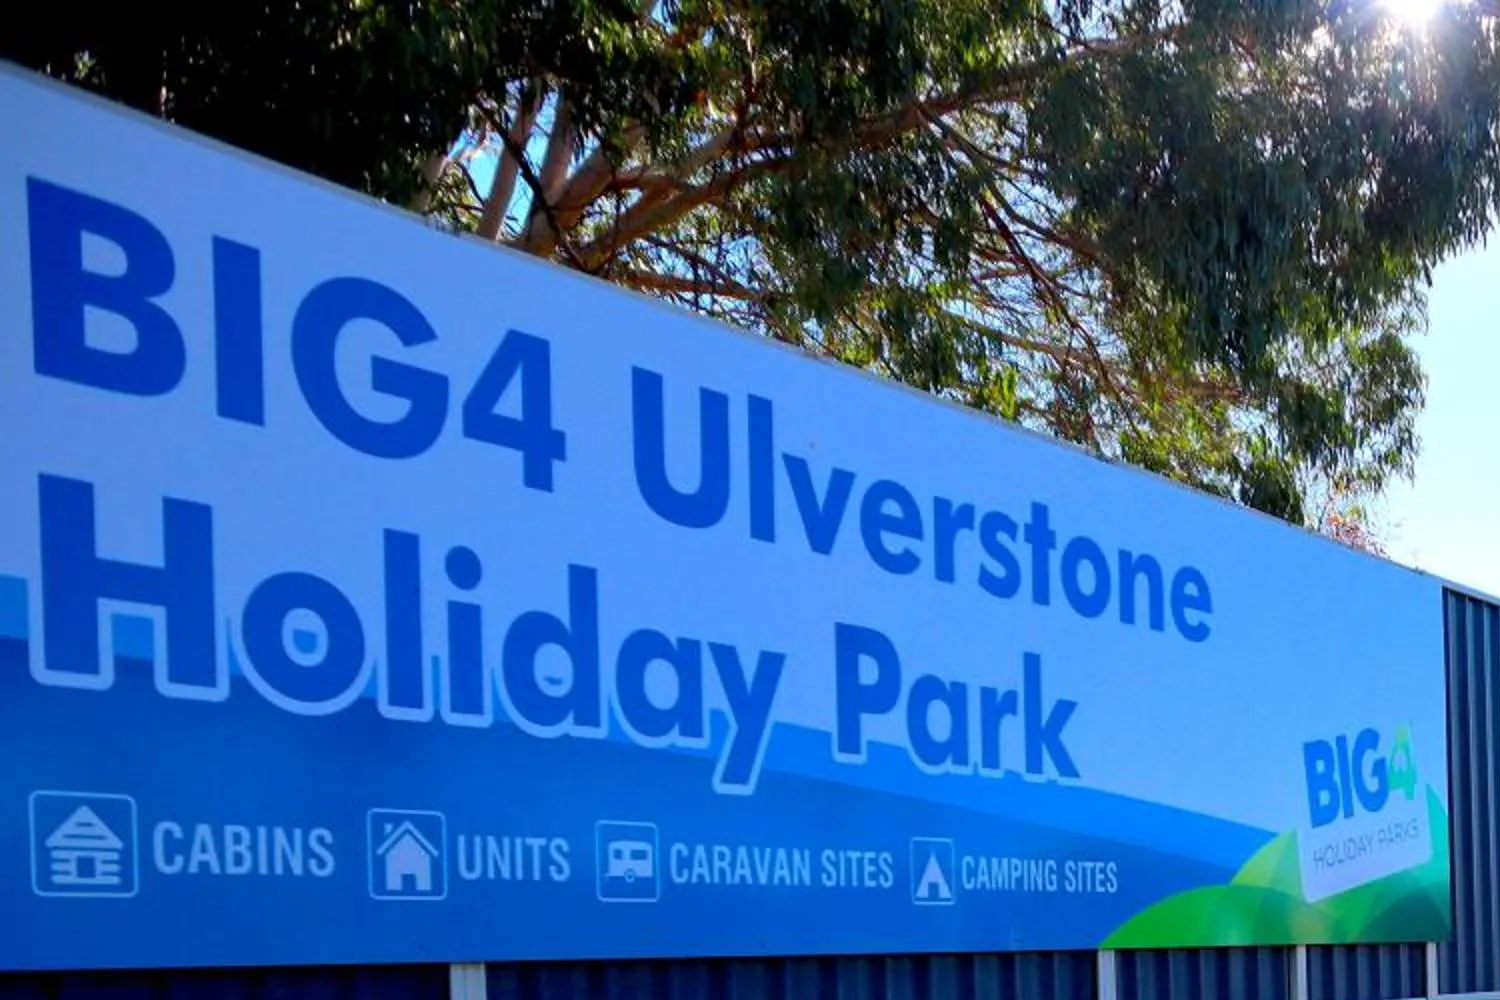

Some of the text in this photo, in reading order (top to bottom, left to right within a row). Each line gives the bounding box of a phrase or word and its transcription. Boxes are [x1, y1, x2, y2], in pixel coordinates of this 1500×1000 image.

[25, 174, 1214, 643] BIG4 Ulverstone
[37, 472, 1081, 787] Holiday Park
[1303, 723, 1418, 829] BIG4
[152, 820, 336, 878] CABINS
[457, 833, 570, 882] UNITS
[670, 842, 894, 888] CARAVAN SITES
[961, 855, 1119, 894] CAMPING SITES
[1312, 832, 1375, 872] HOLIDAY
